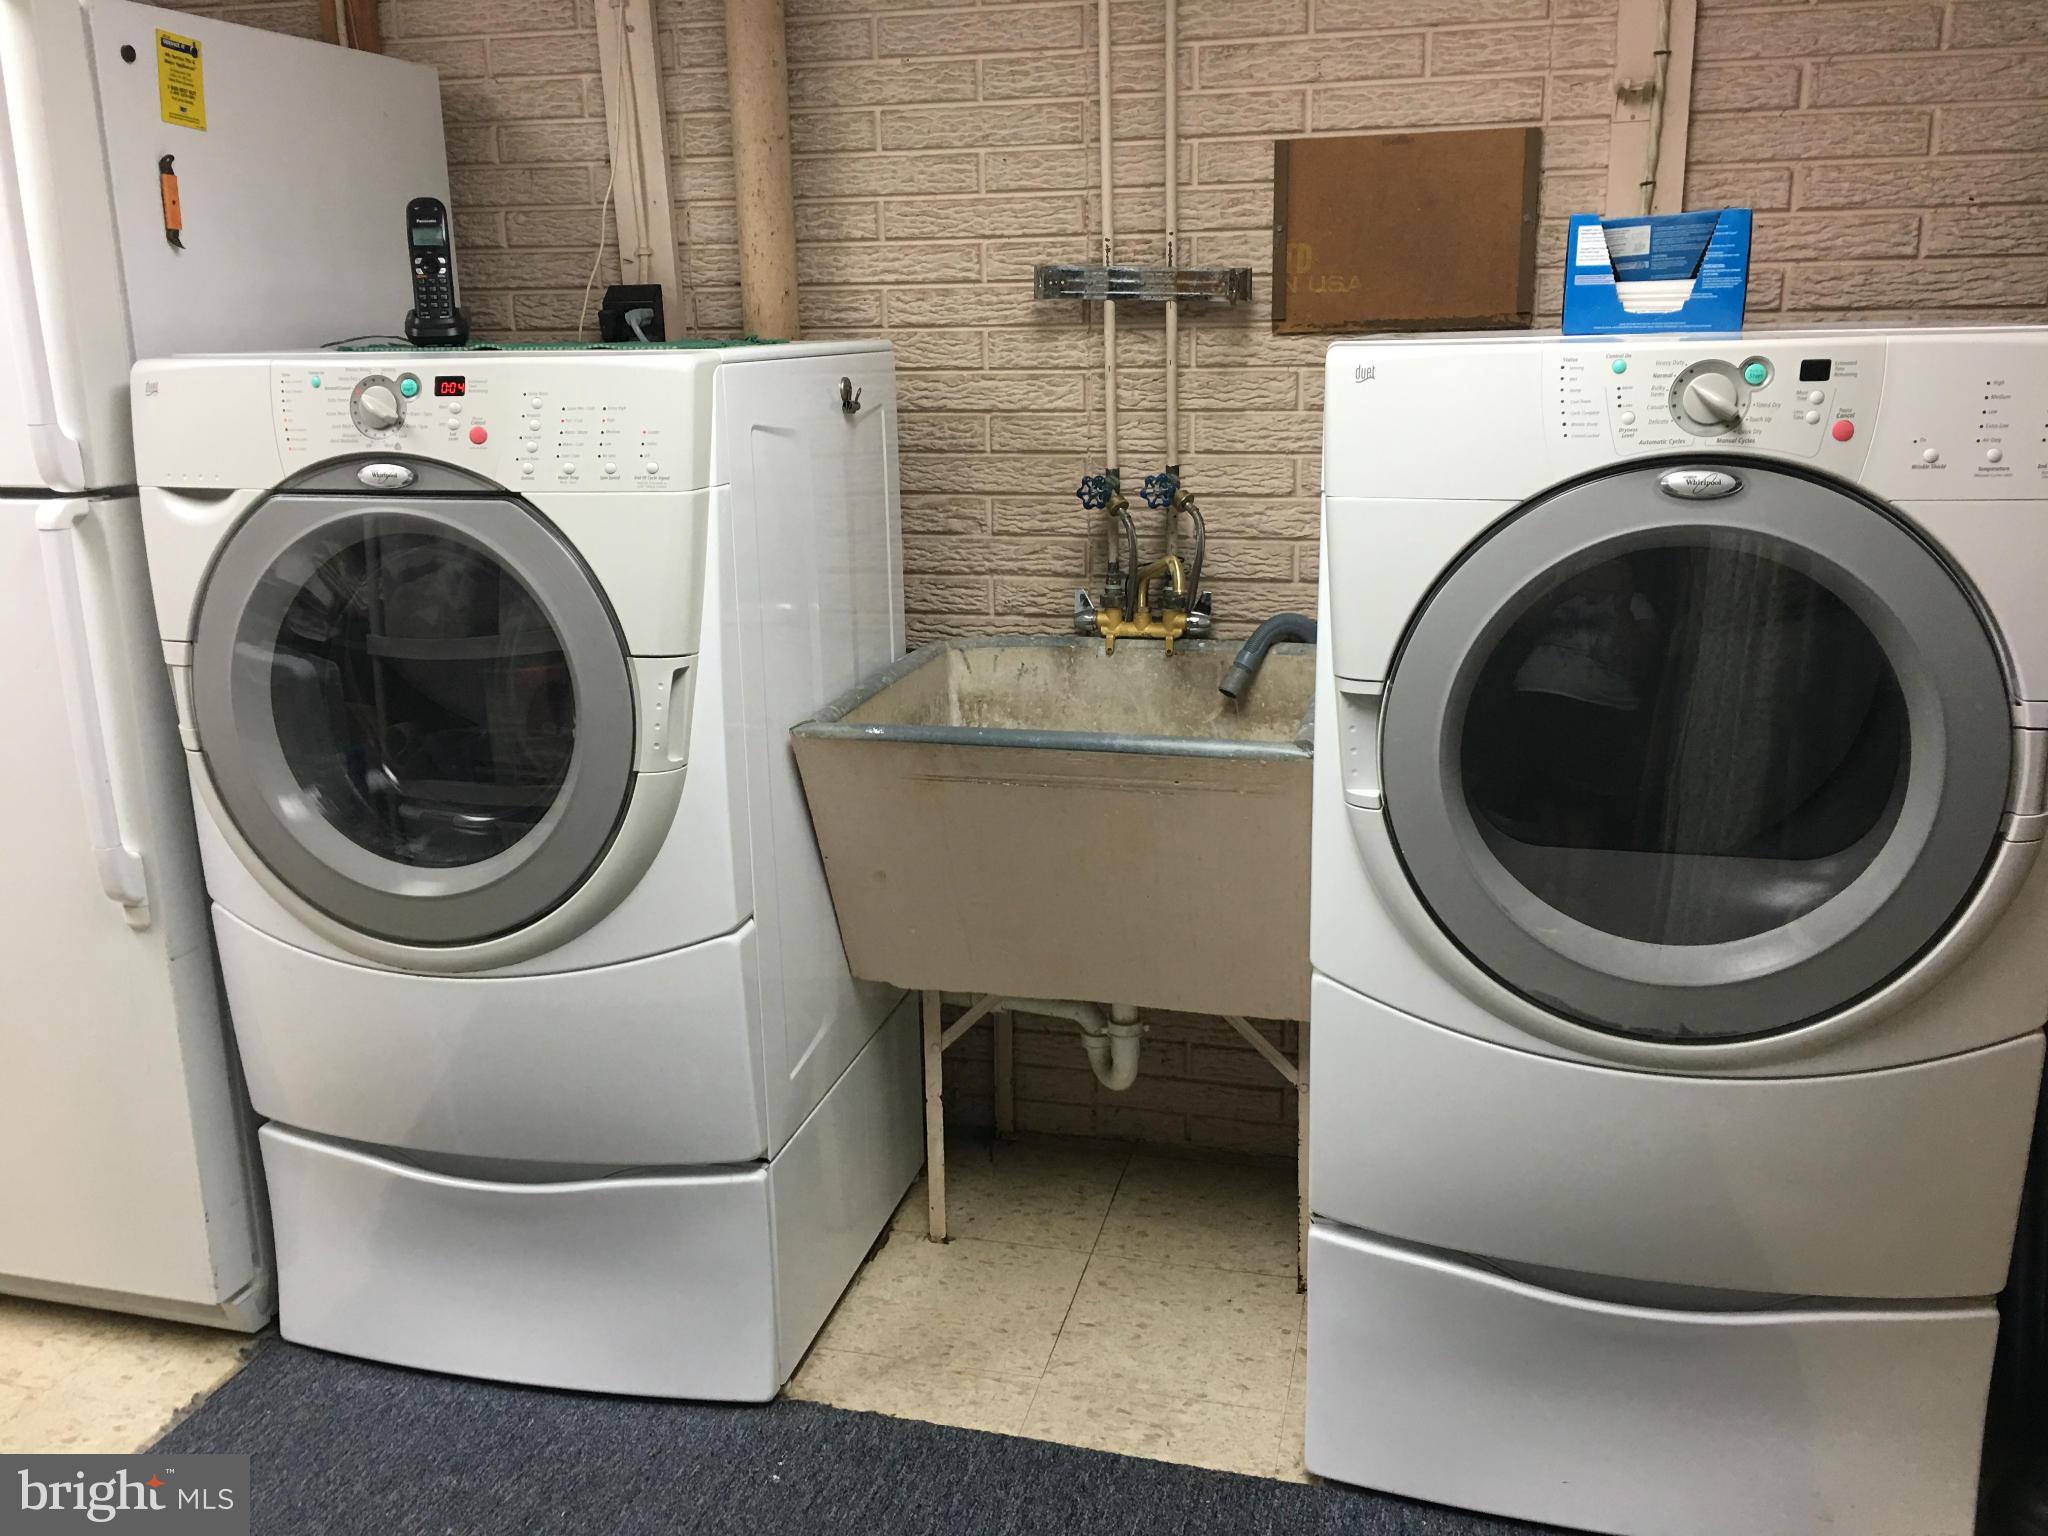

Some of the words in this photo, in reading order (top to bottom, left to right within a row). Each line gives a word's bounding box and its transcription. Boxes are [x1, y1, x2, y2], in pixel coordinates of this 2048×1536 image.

[1308, 273, 1361, 295] USA
[1355, 364, 1376, 383] duet
[441, 382, 465, 394] 0:04
[1668, 438, 1686, 446] Cycles
[1738, 437, 1756, 445] Cycles
[372, 471, 398, 479] Whirlpool
[1685, 479, 1722, 488] Whirlpool
